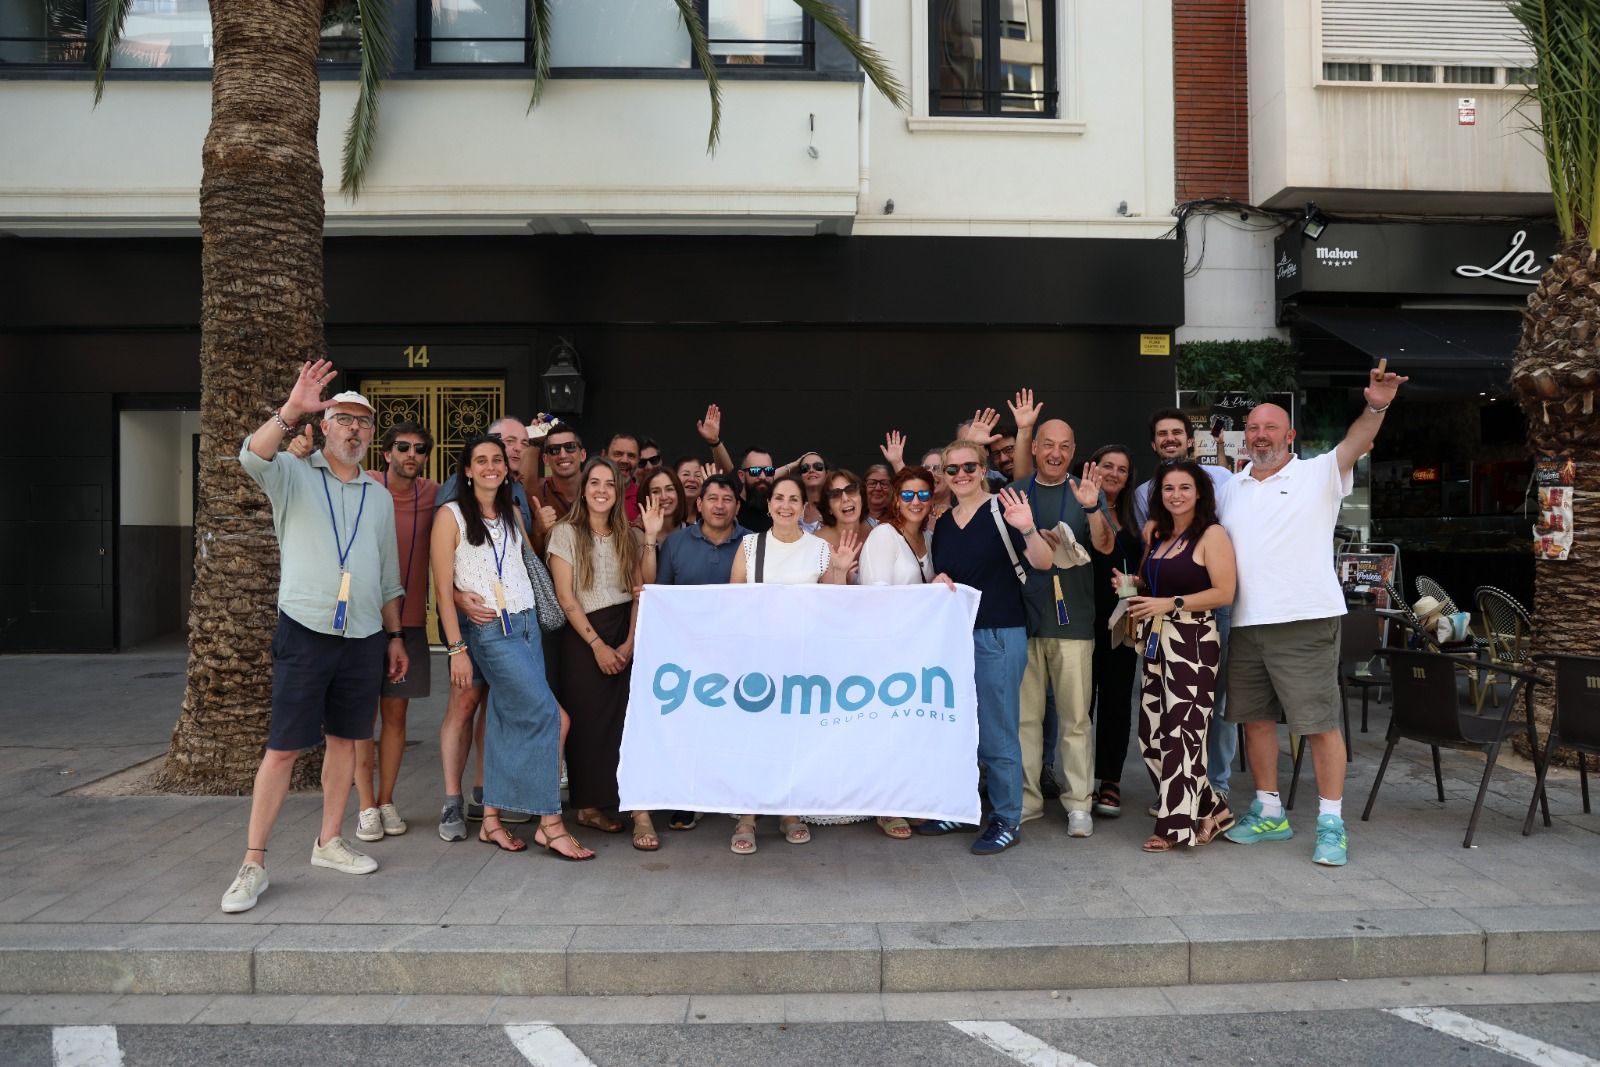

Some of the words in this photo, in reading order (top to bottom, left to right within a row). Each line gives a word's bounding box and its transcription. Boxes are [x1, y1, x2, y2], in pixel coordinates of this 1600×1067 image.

[1316, 247, 1358, 259] Mahou
[1456, 230, 1541, 284] La
[403, 345, 430, 368] 14
[652, 662, 955, 716] geomoon
[820, 711, 878, 727] GRUPO
